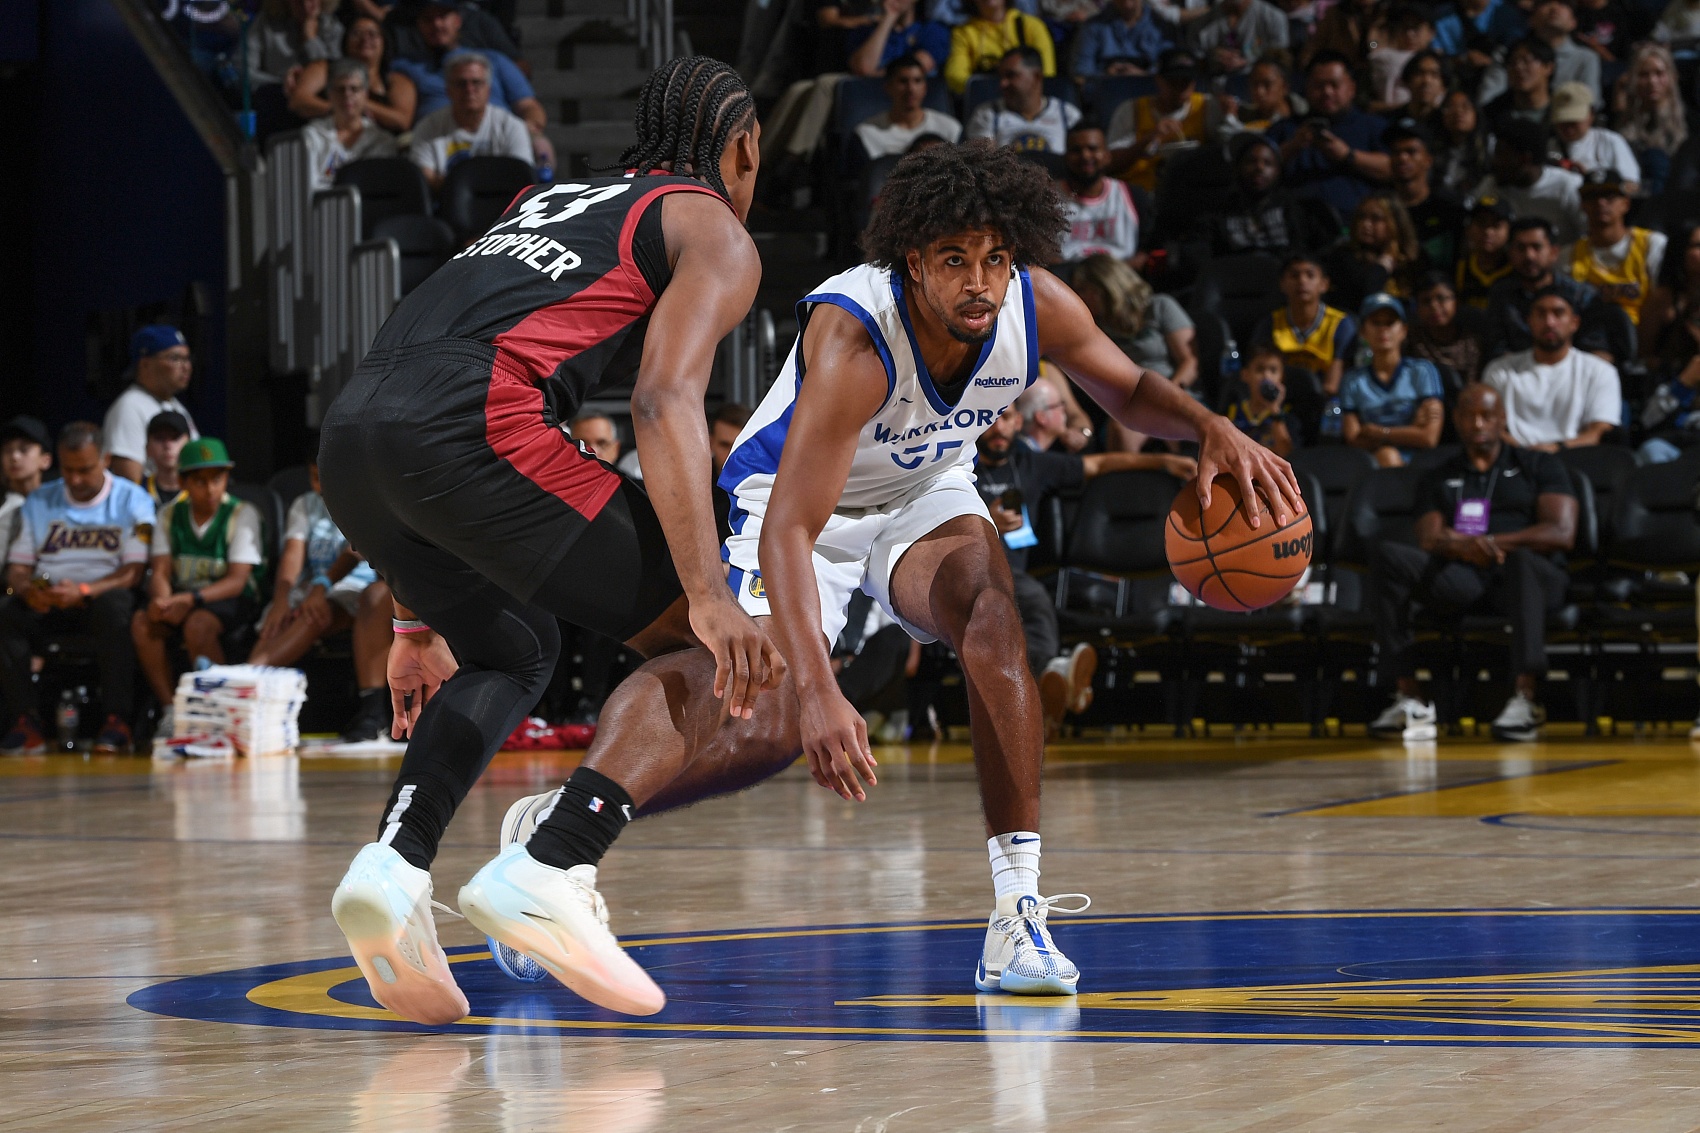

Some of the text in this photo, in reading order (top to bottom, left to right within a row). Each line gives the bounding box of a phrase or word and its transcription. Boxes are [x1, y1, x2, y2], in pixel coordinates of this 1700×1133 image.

[451, 233, 582, 282] STOPHER
[974, 376, 1020, 388] Rakuten
[41, 521, 123, 554] LAKERS
